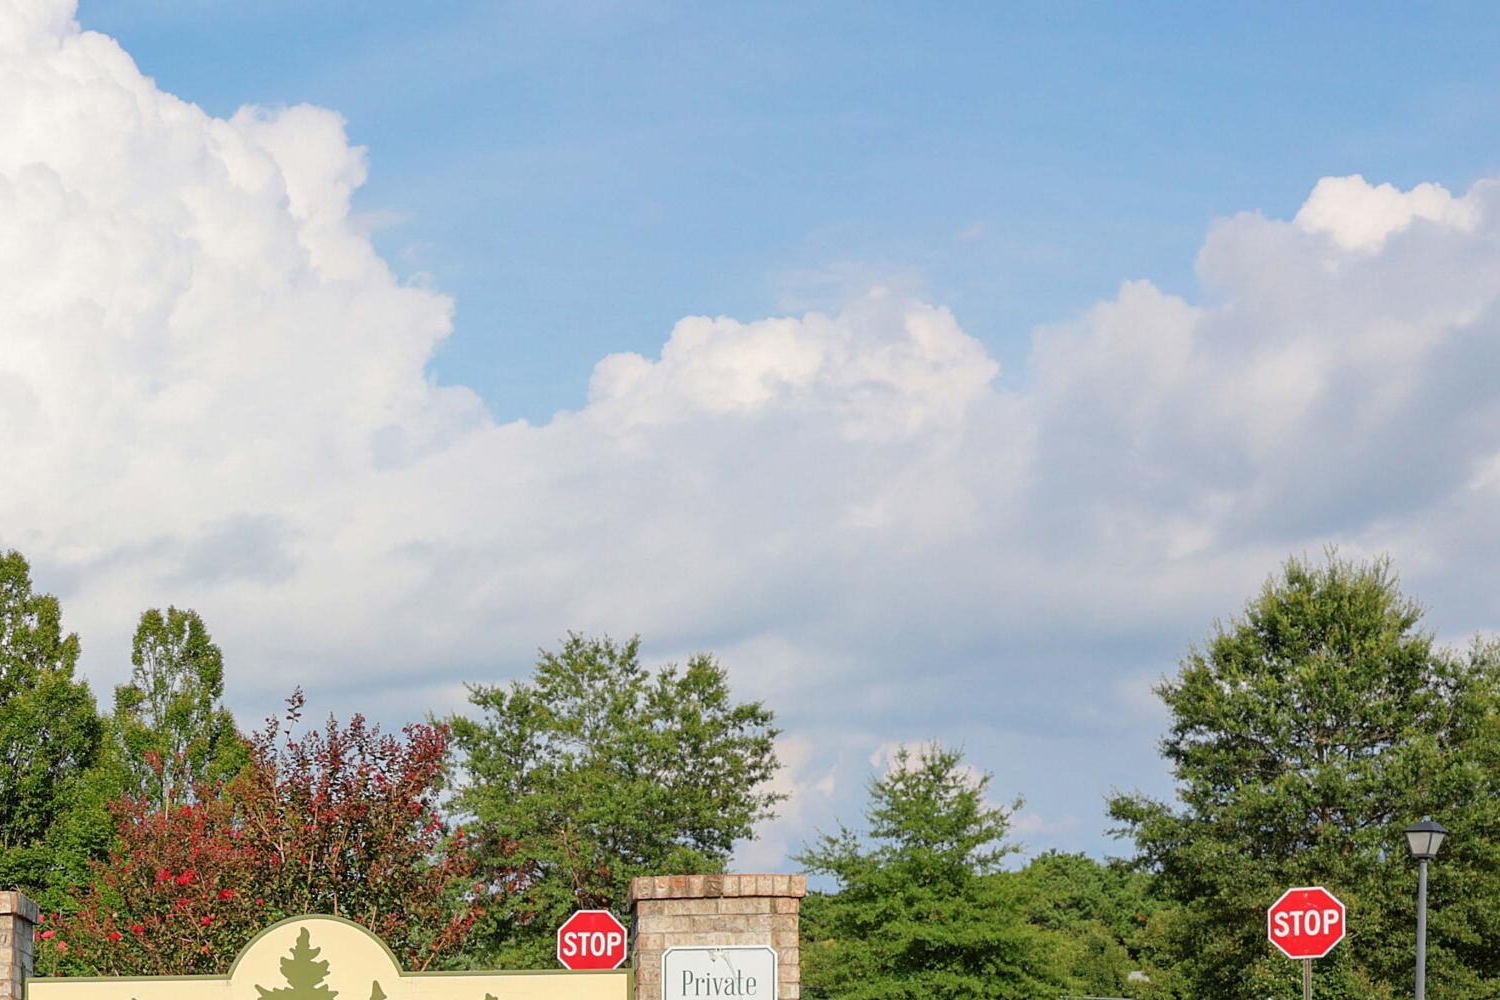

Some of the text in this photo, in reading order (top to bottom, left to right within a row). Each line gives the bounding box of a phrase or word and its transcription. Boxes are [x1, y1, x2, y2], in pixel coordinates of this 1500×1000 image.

[1273, 909, 1340, 938] STOP
[562, 931, 622, 957] STOP
[681, 969, 757, 997] Private
